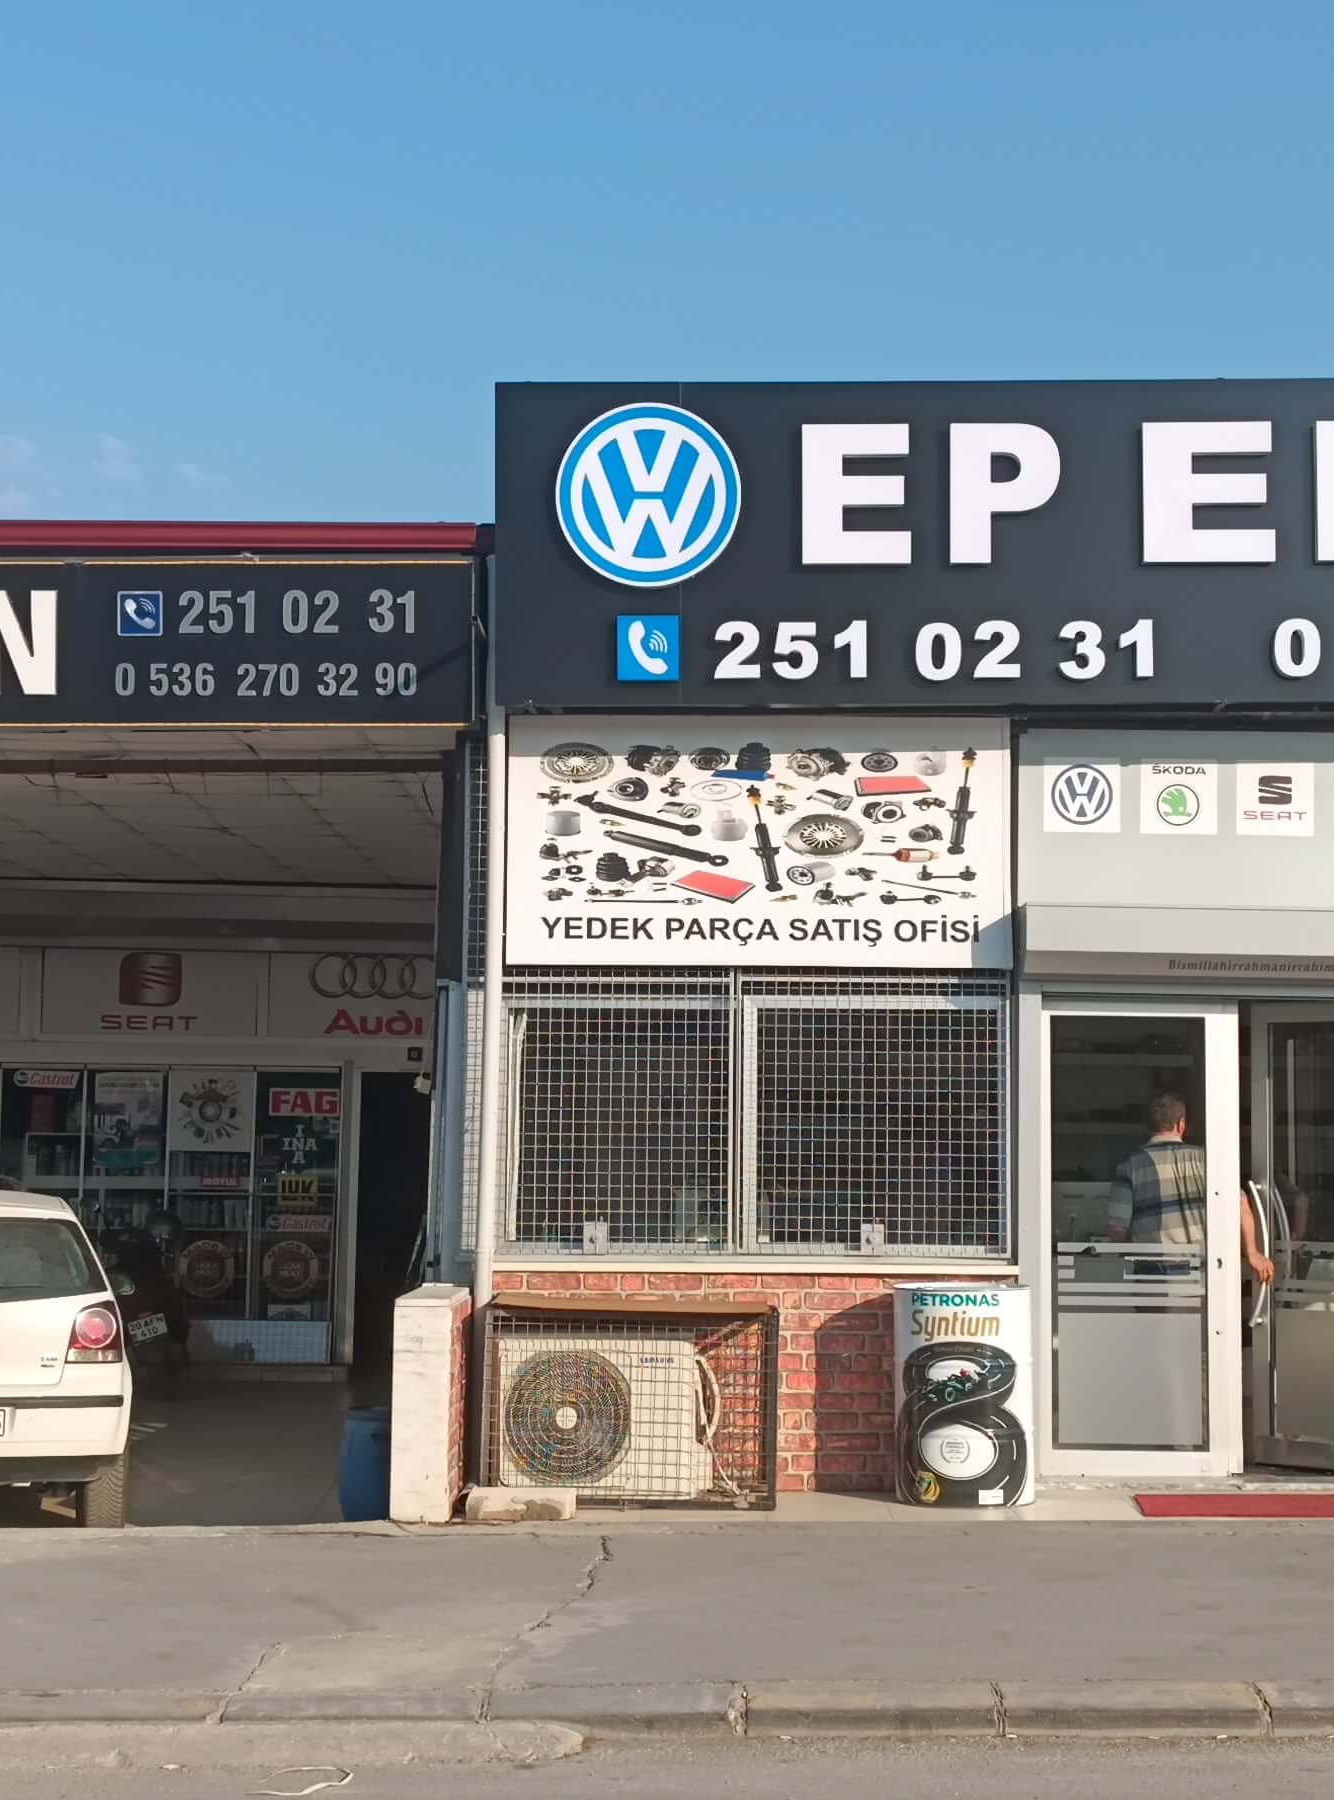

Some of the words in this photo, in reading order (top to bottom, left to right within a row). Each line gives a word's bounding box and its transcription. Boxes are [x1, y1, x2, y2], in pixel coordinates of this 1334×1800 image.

[802, 421, 1062, 565] EP
[178, 590, 255, 635] 251
[282, 590, 339, 634] 02
[368, 589, 416, 634] 31
[714, 619, 867, 680] 251
[915, 620, 1022, 681] 02
[1058, 618, 1154, 680] 31
[1272, 618, 1321, 677] 0
[116, 663, 135, 697] 0
[149, 662, 214, 697] 536
[236, 662, 300, 697] 270
[316, 662, 359, 696] 32
[375, 662, 417, 696] 90
[1152, 763, 1207, 776] ŠKODA
[1242, 810, 1308, 822] SEAT
[540, 916, 654, 940] YEDEK
[665, 917, 780, 947] PARÇA
[788, 918, 884, 948] SATIŞ
[894, 914, 981, 944] OFİSİ
[100, 1015, 198, 1031] SEAT
[323, 1009, 424, 1036] Audi
[30, 1071, 76, 1086] Castrol
[271, 1091, 338, 1115] FAG
[911, 1293, 1000, 1307] PETRONAS
[910, 1309, 1001, 1343] Syntium
